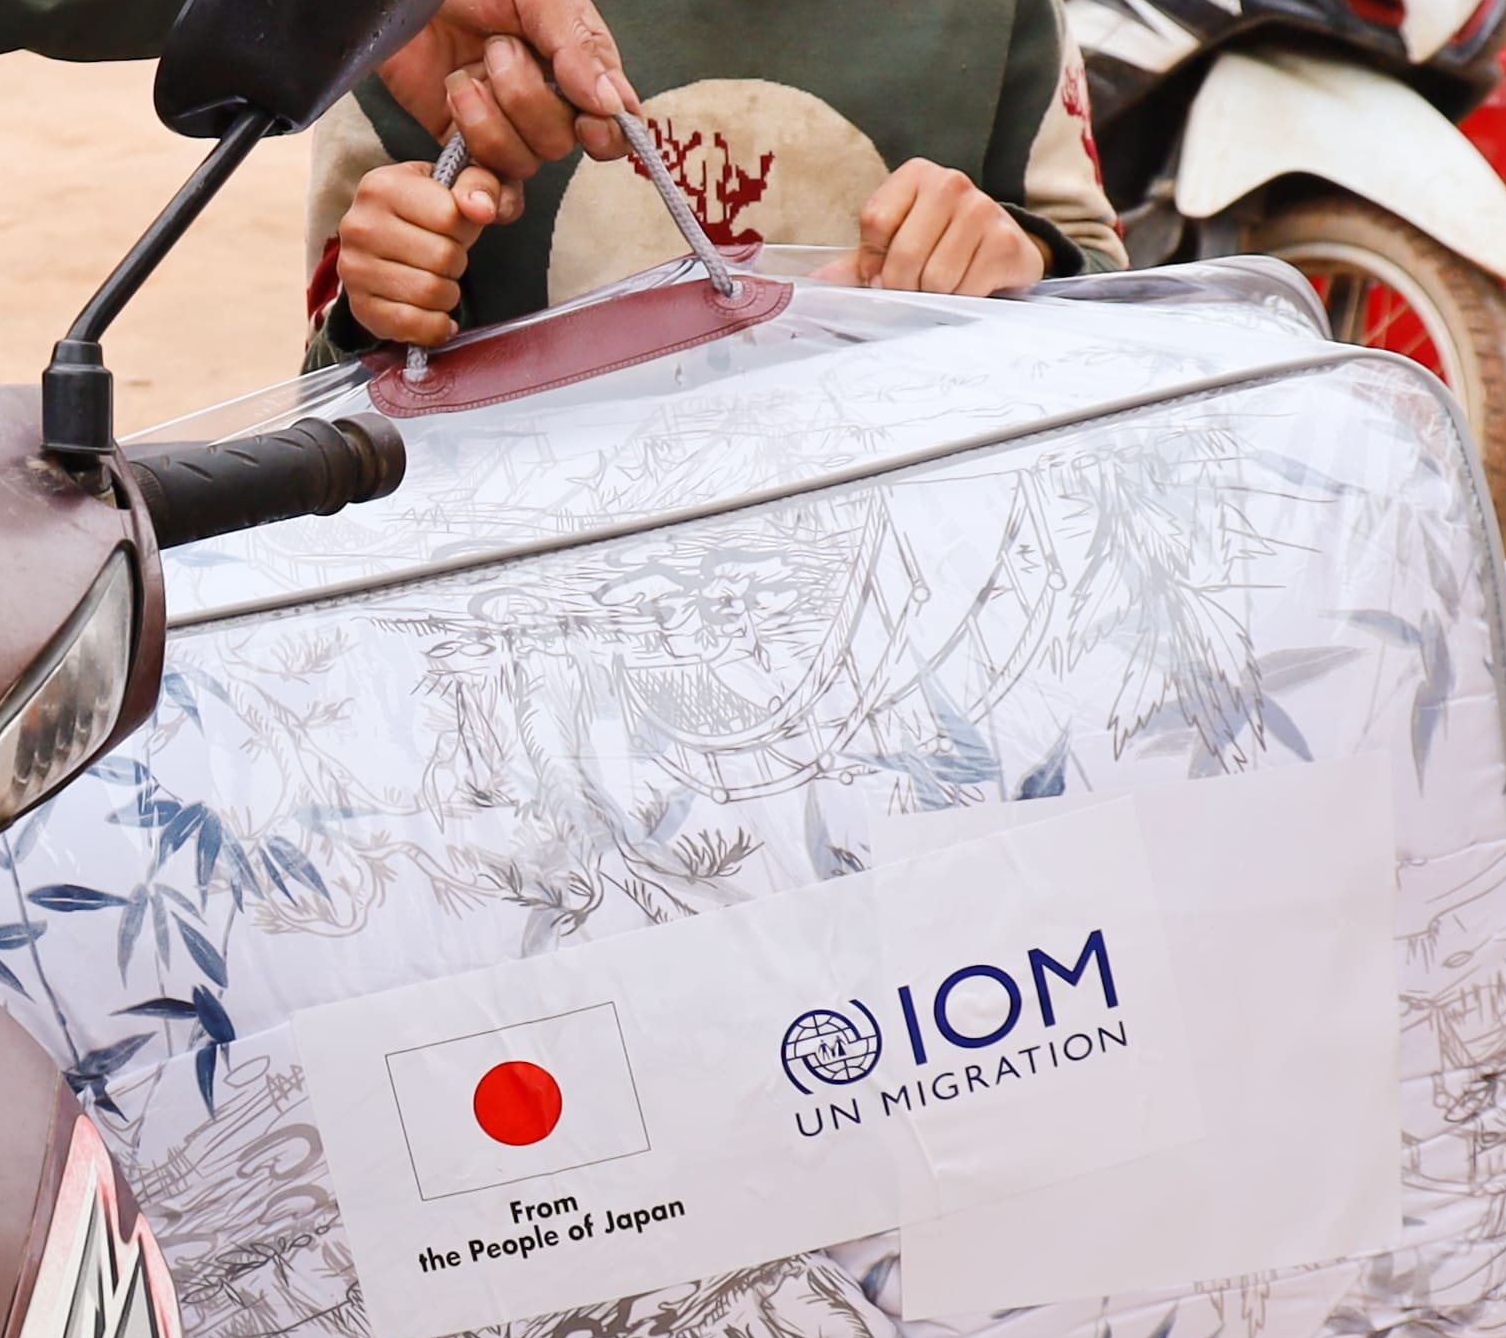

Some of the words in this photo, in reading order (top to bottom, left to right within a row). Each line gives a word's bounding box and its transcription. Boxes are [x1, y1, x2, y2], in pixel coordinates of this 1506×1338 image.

[898, 929, 1119, 1065] IOM
[795, 1098, 861, 1137] UN
[881, 1021, 1128, 1116] MIGRATION
[418, 1247, 462, 1272] the
[468, 1224, 559, 1262] People
[568, 1213, 595, 1241] of
[604, 1200, 686, 1234] Japan
[509, 1195, 578, 1224] From
